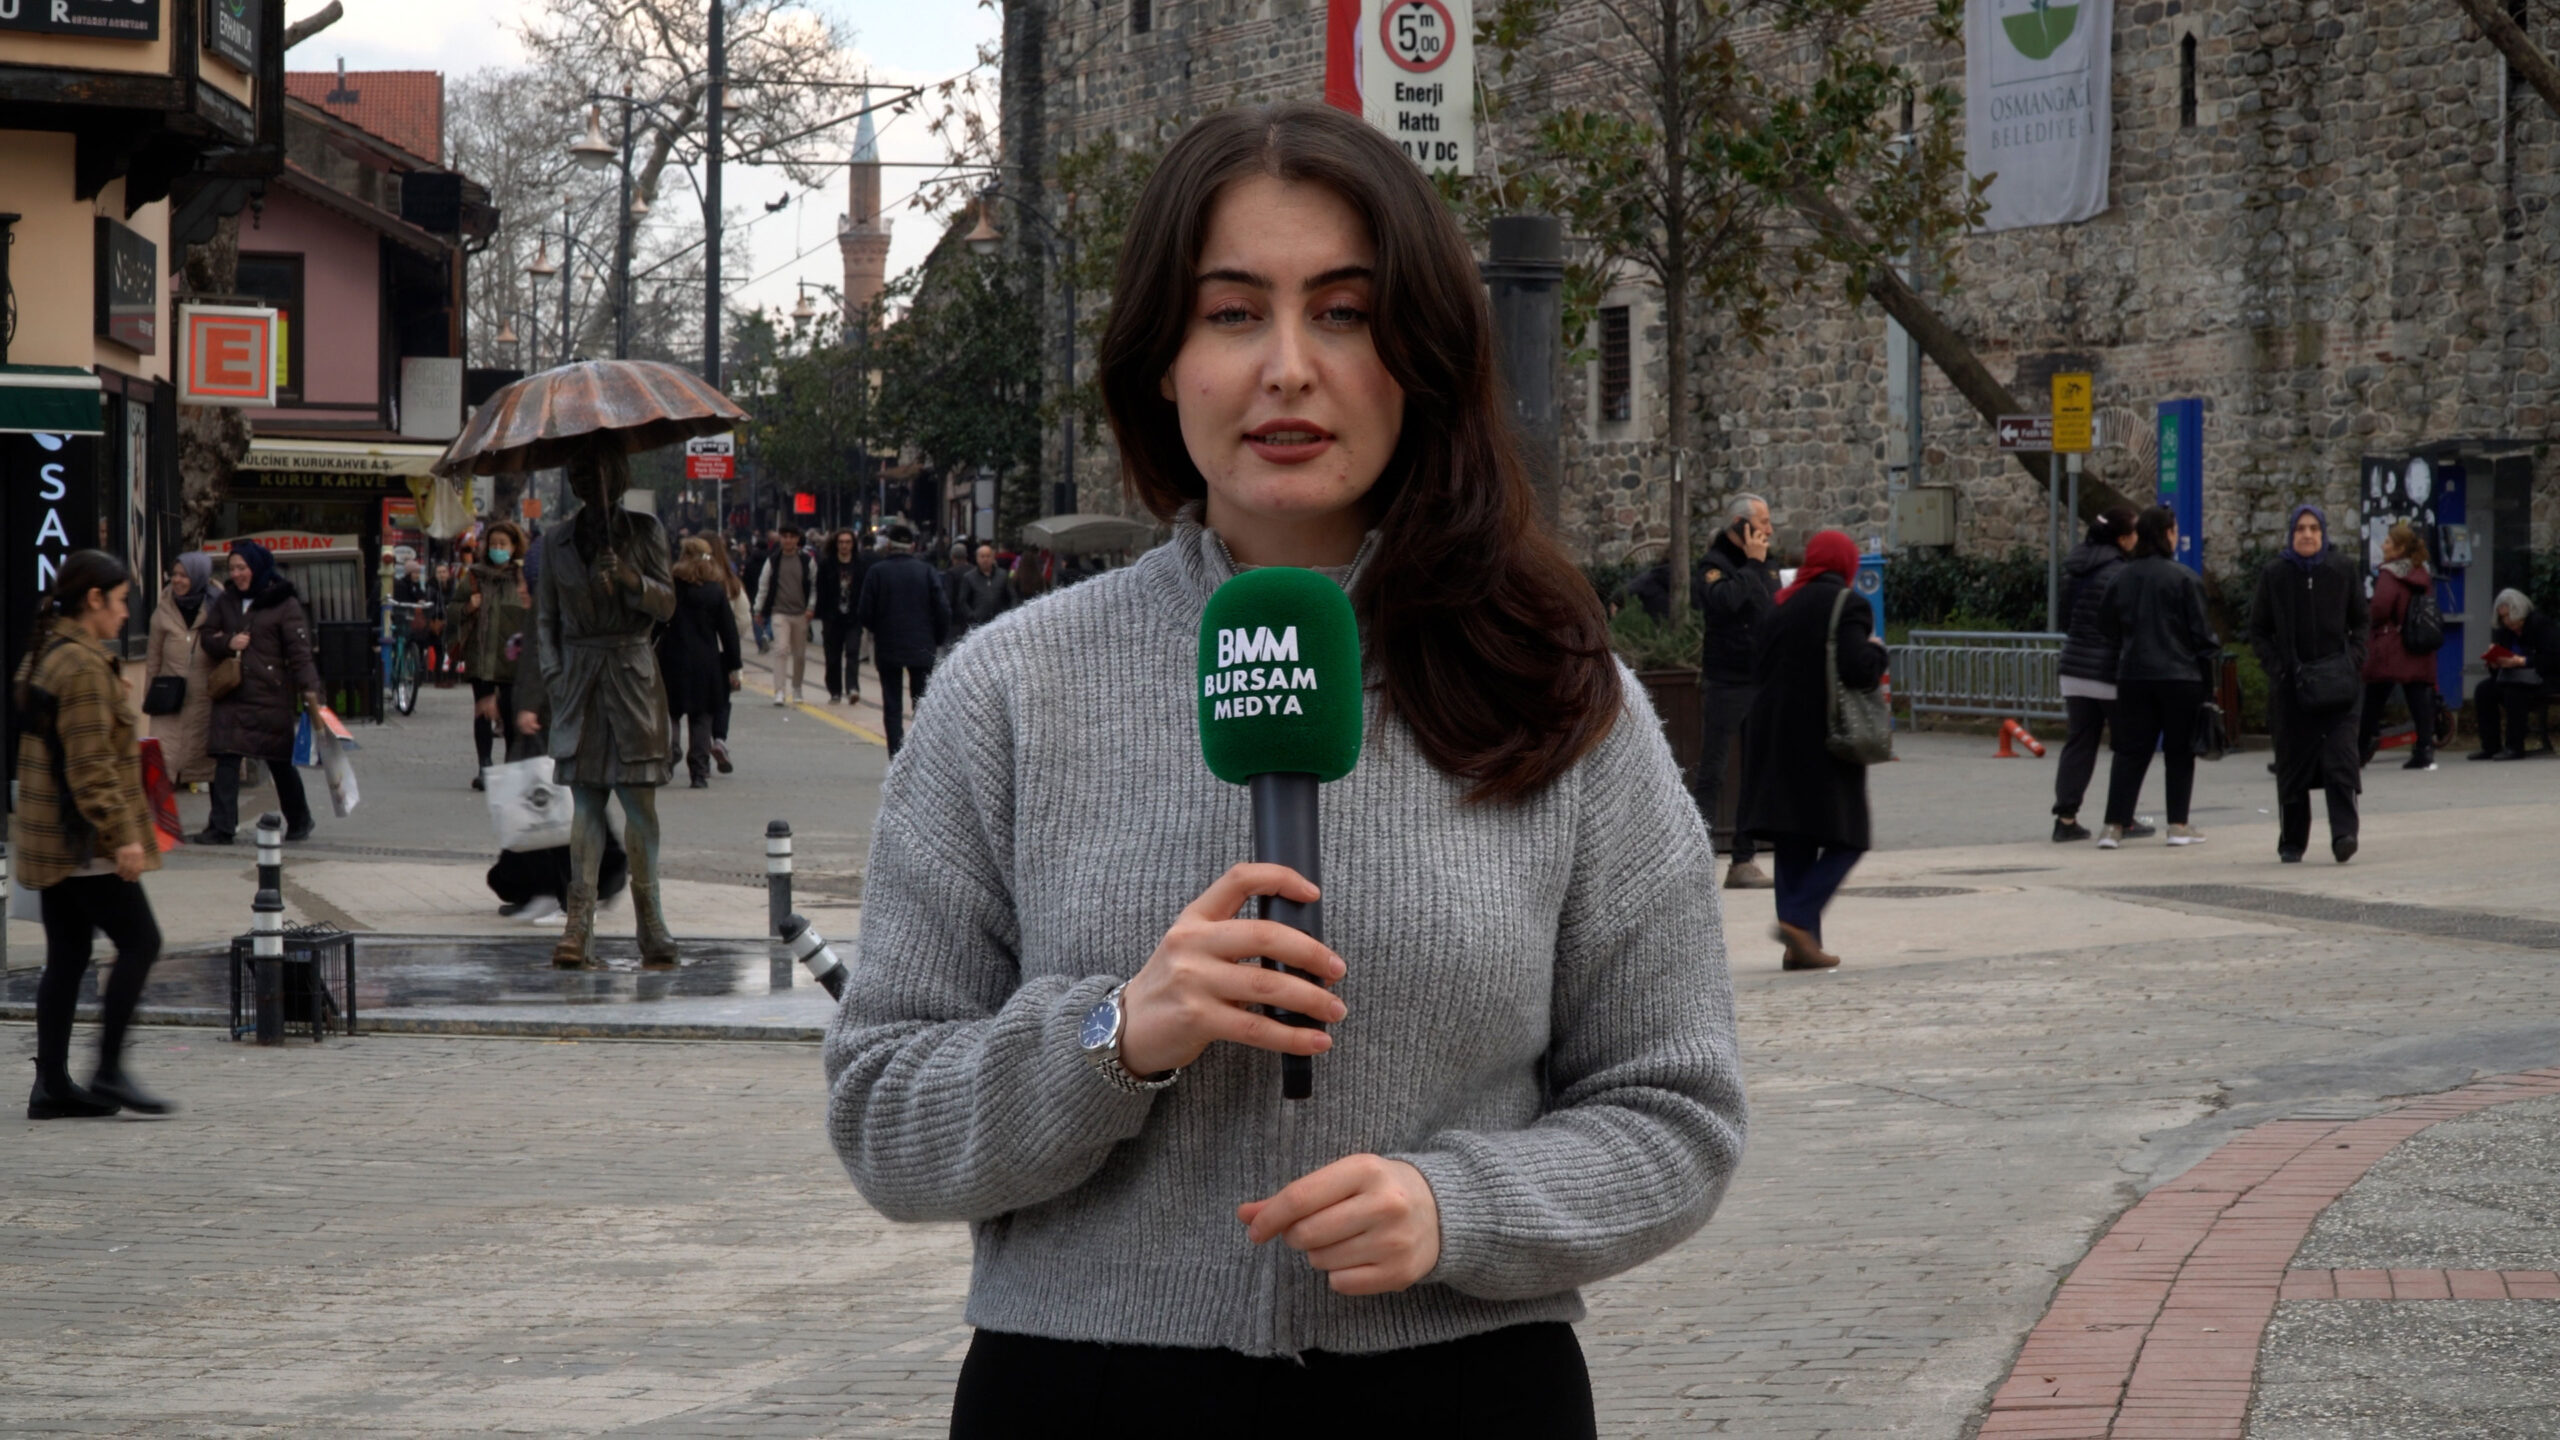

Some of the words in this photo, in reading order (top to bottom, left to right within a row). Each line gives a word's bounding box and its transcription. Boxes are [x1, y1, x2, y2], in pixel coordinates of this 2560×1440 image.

[1395, 82, 1443, 107] Enerji
[1398, 111, 1440, 132] Hattı
[1417, 141, 1429, 160] V
[1435, 141, 1458, 161] DC
[205, 327, 252, 386] E
[293, 454, 367, 470] KURUKAHVE
[260, 473, 315, 486] KURU
[321, 474, 387, 488] KAHVE
[1217, 625, 1300, 668] BMM
[1204, 668, 1318, 698] BURSAM
[1214, 694, 1303, 721] MEDYA
